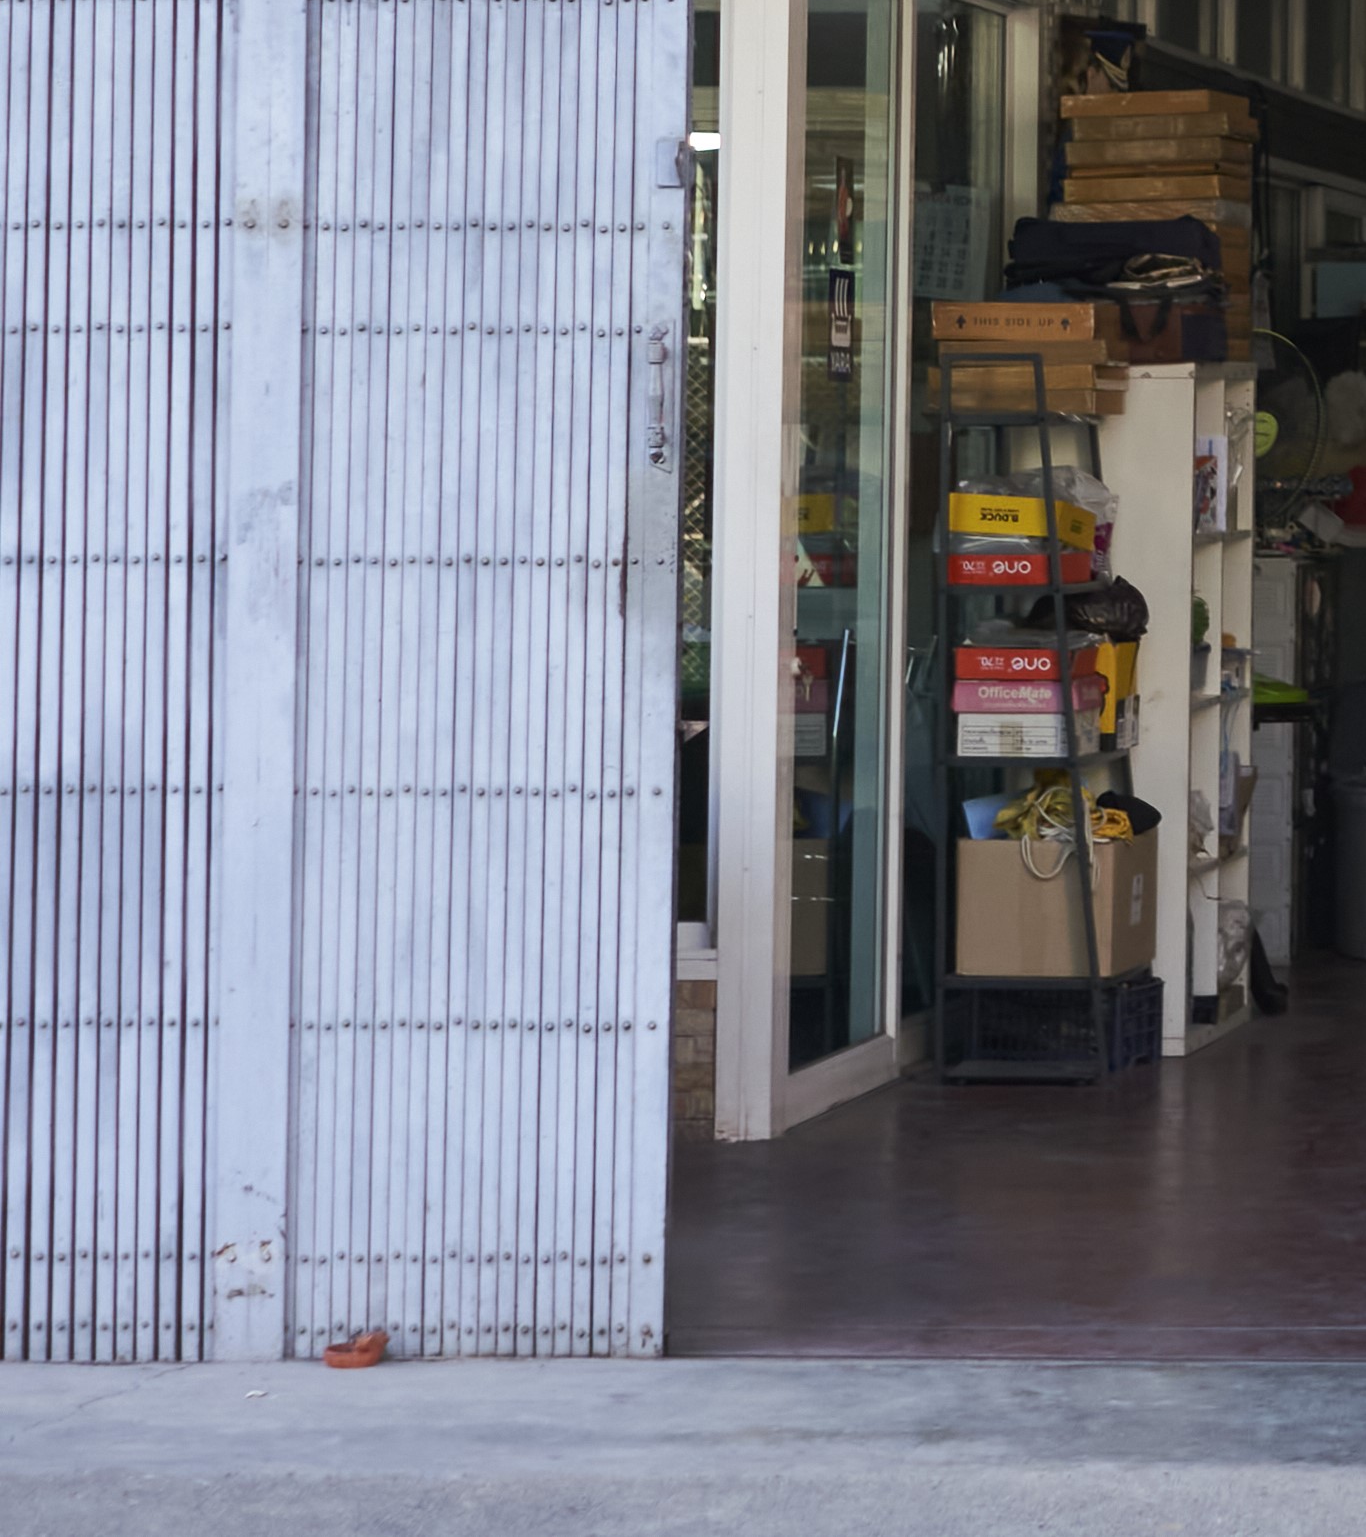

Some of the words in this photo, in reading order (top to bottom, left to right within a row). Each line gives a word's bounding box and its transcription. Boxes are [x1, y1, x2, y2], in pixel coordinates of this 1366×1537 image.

[973, 317, 999, 327] THIS
[1005, 317, 1031, 327] SIDE
[1038, 318, 1055, 328] UP
[992, 560, 1031, 574] one
[1011, 656, 1051, 671] one
[978, 686, 1052, 702] OfficeMate
